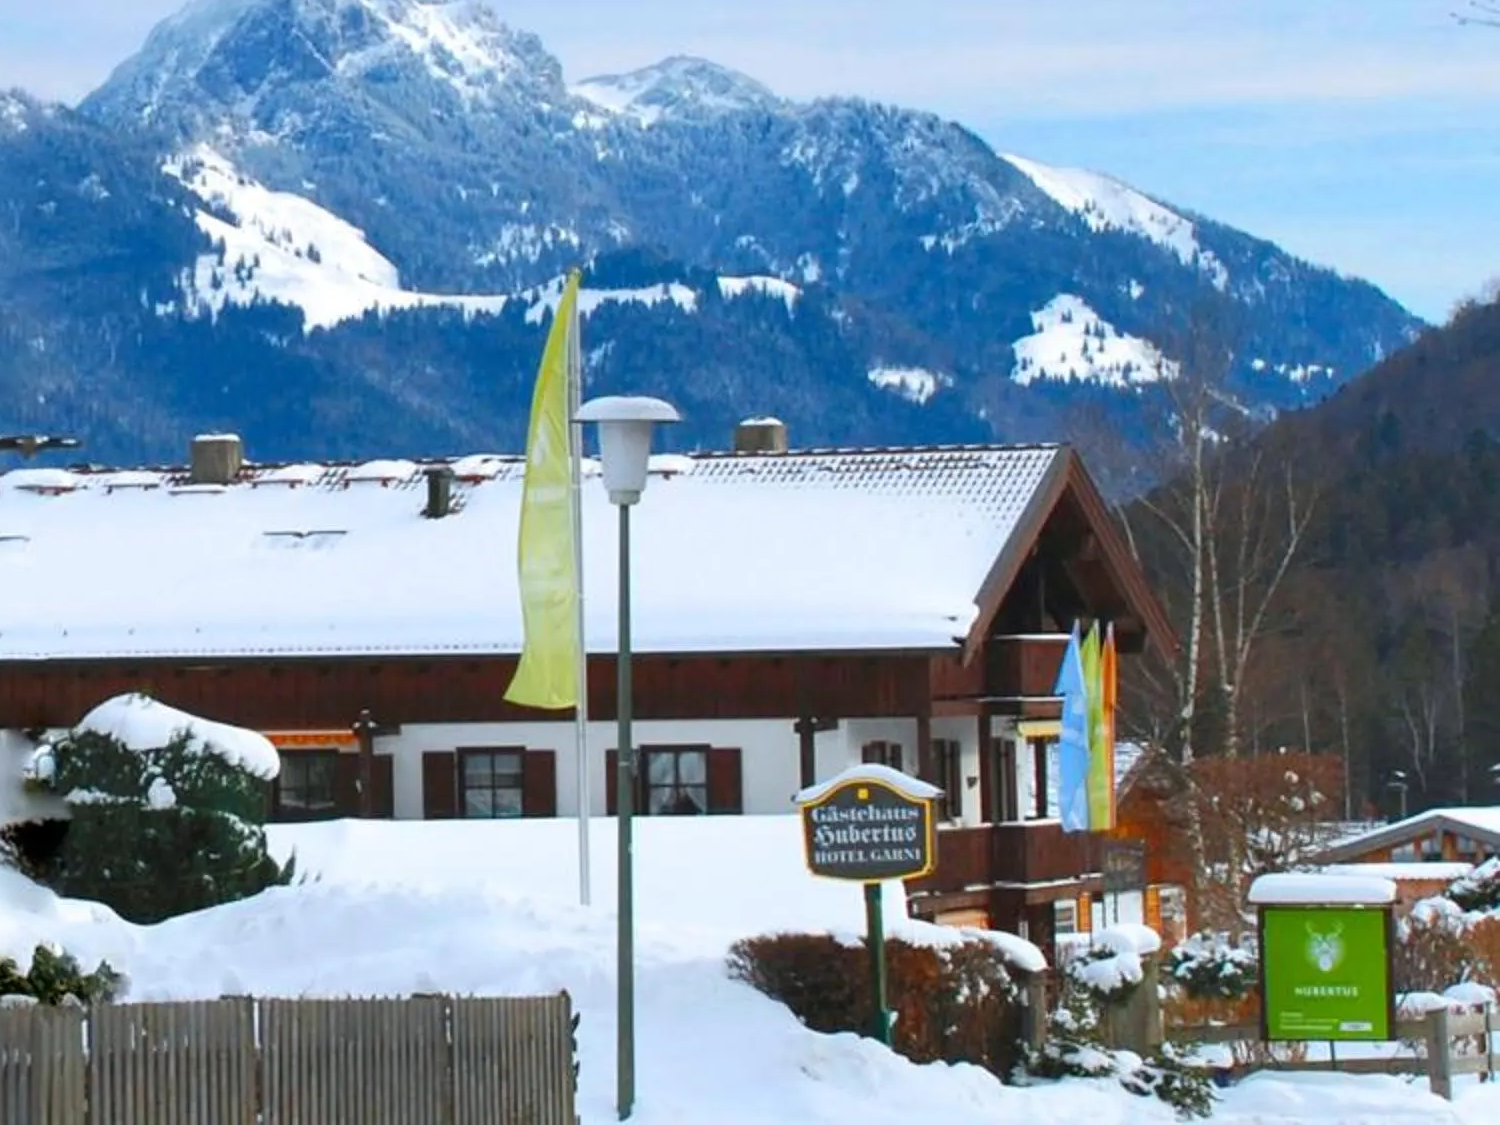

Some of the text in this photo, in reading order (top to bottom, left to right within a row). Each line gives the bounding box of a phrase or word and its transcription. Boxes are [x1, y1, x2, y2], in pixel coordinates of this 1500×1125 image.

[811, 804, 919, 823] Gästehaus
[813, 824, 917, 847] Hubertus
[814, 847, 921, 864] HOTEL GARNI
[1294, 985, 1359, 998] HUBERTUS
